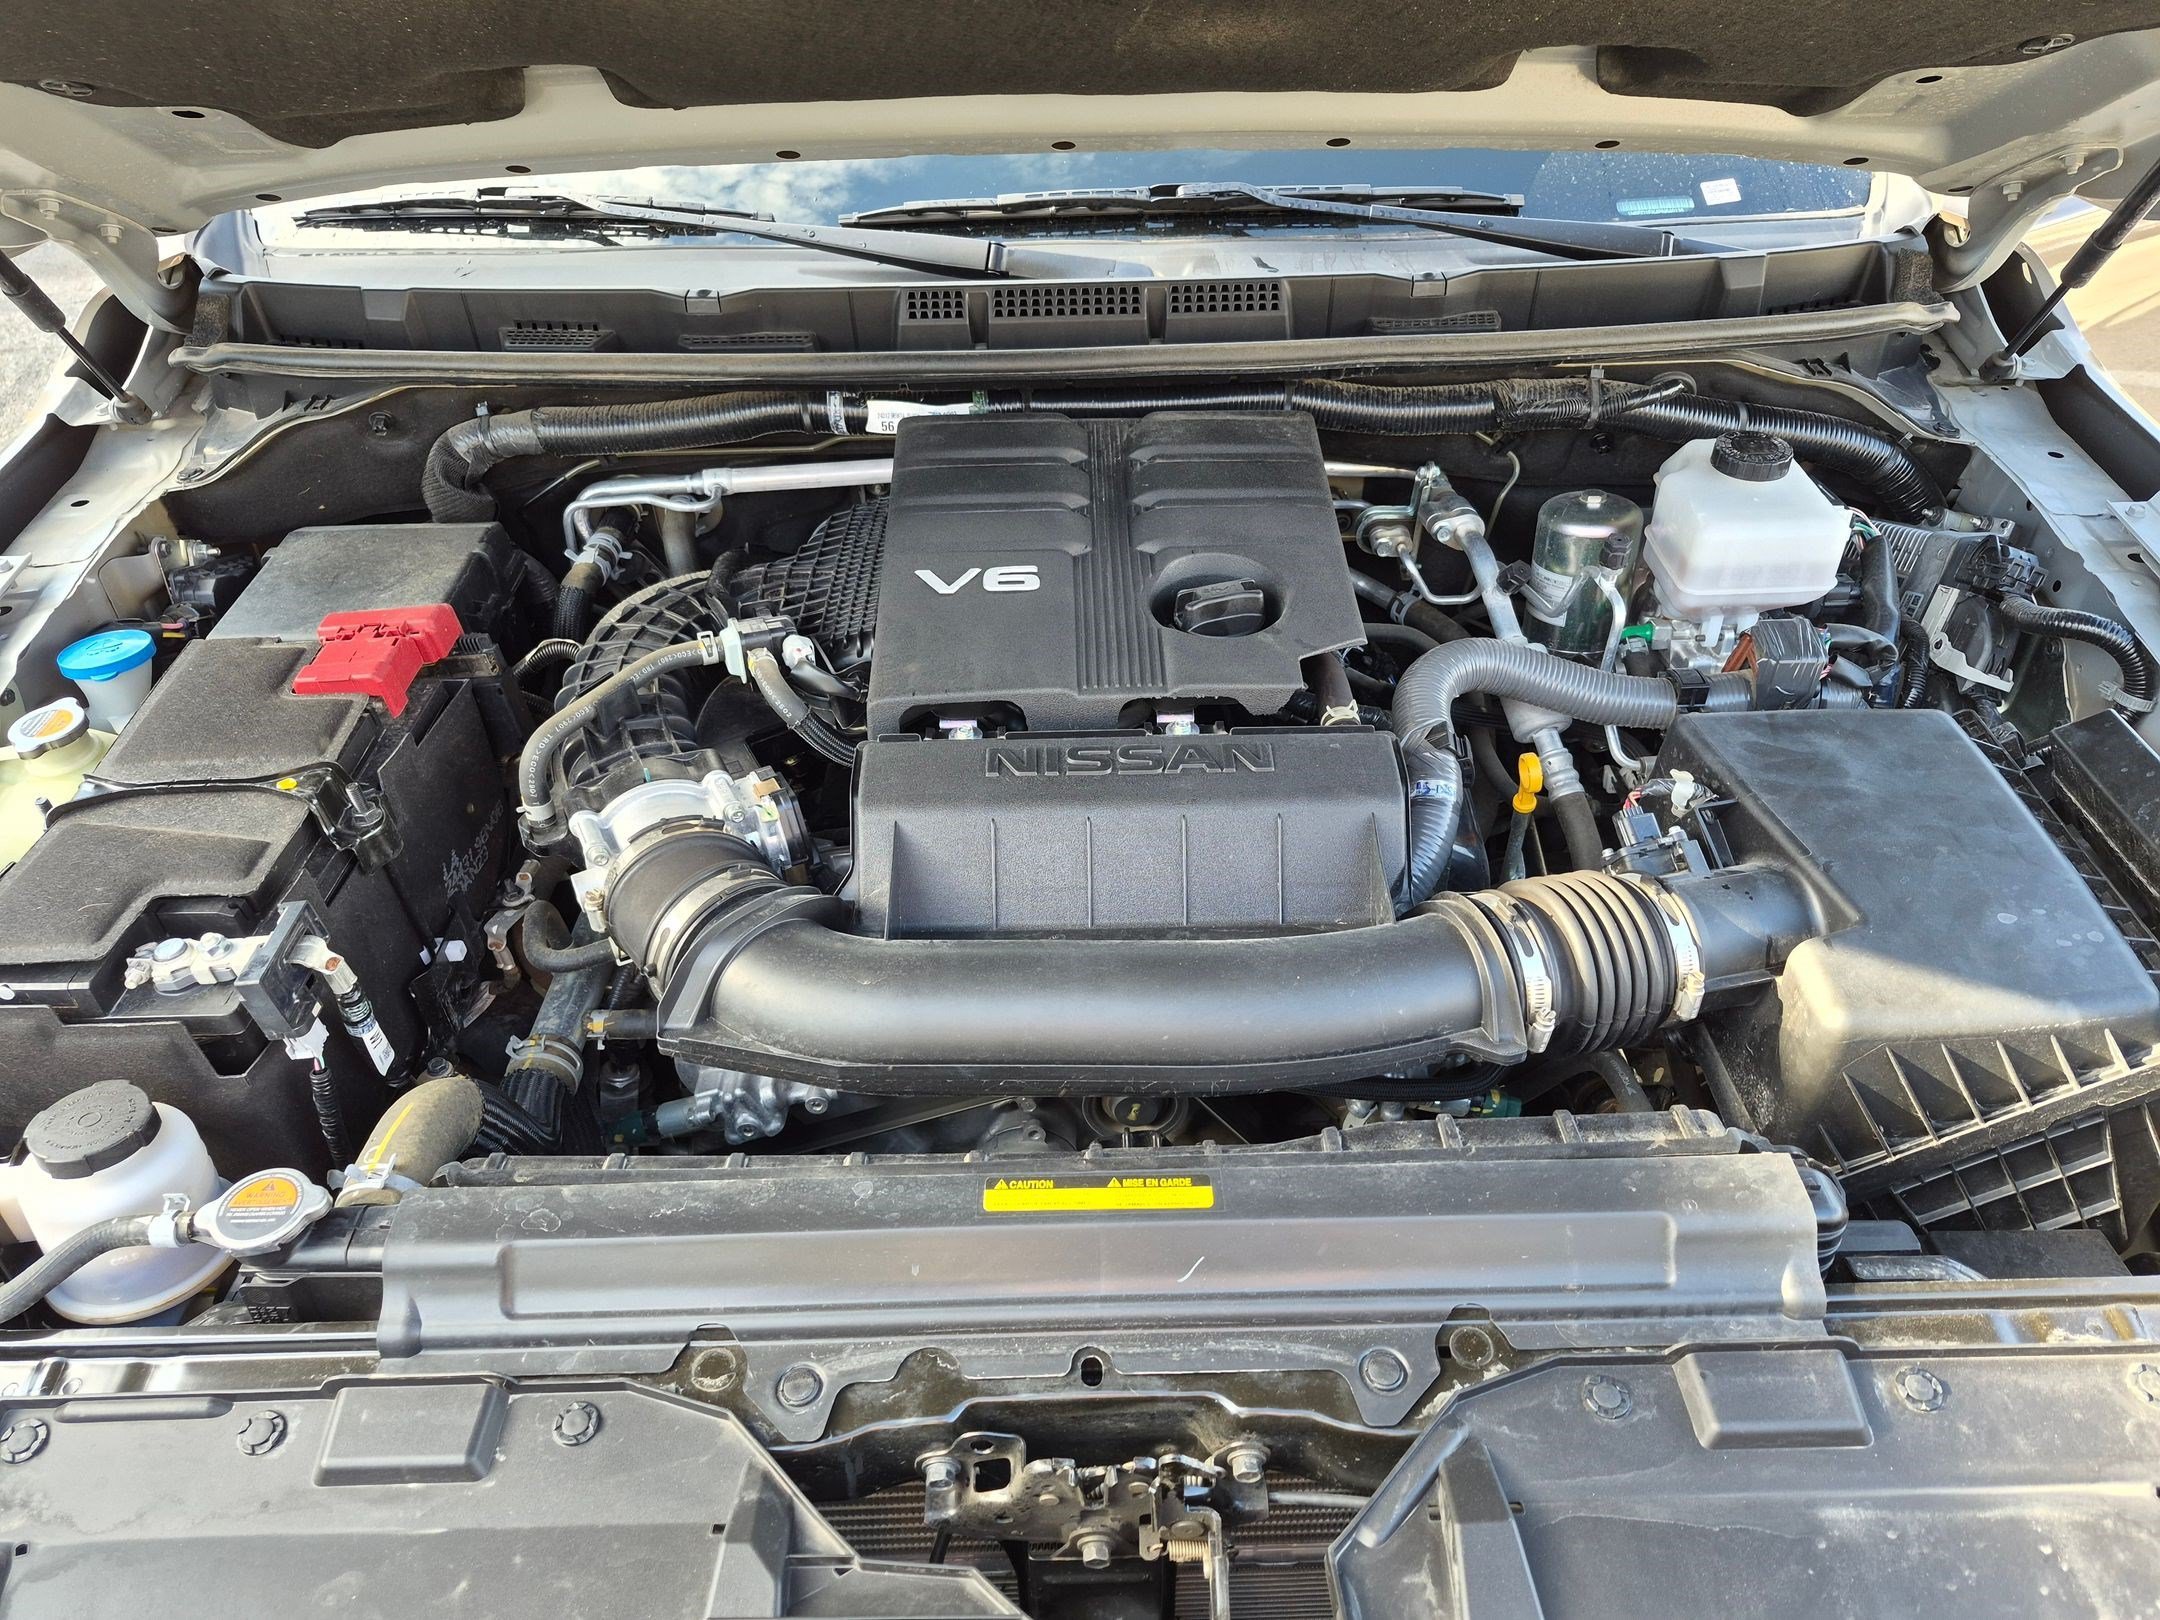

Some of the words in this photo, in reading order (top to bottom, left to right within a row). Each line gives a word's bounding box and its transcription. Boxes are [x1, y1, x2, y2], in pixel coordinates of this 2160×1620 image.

[914, 565, 1041, 595] V6
[985, 743, 1276, 777] NISSAN
[1009, 1179, 1054, 1189] CAUTION
[1122, 1178, 1145, 1187] MISE
[1146, 1178, 1158, 1187] EN
[1160, 1177, 1192, 1187] GARDE
[245, 1191, 286, 1199] WARNING
